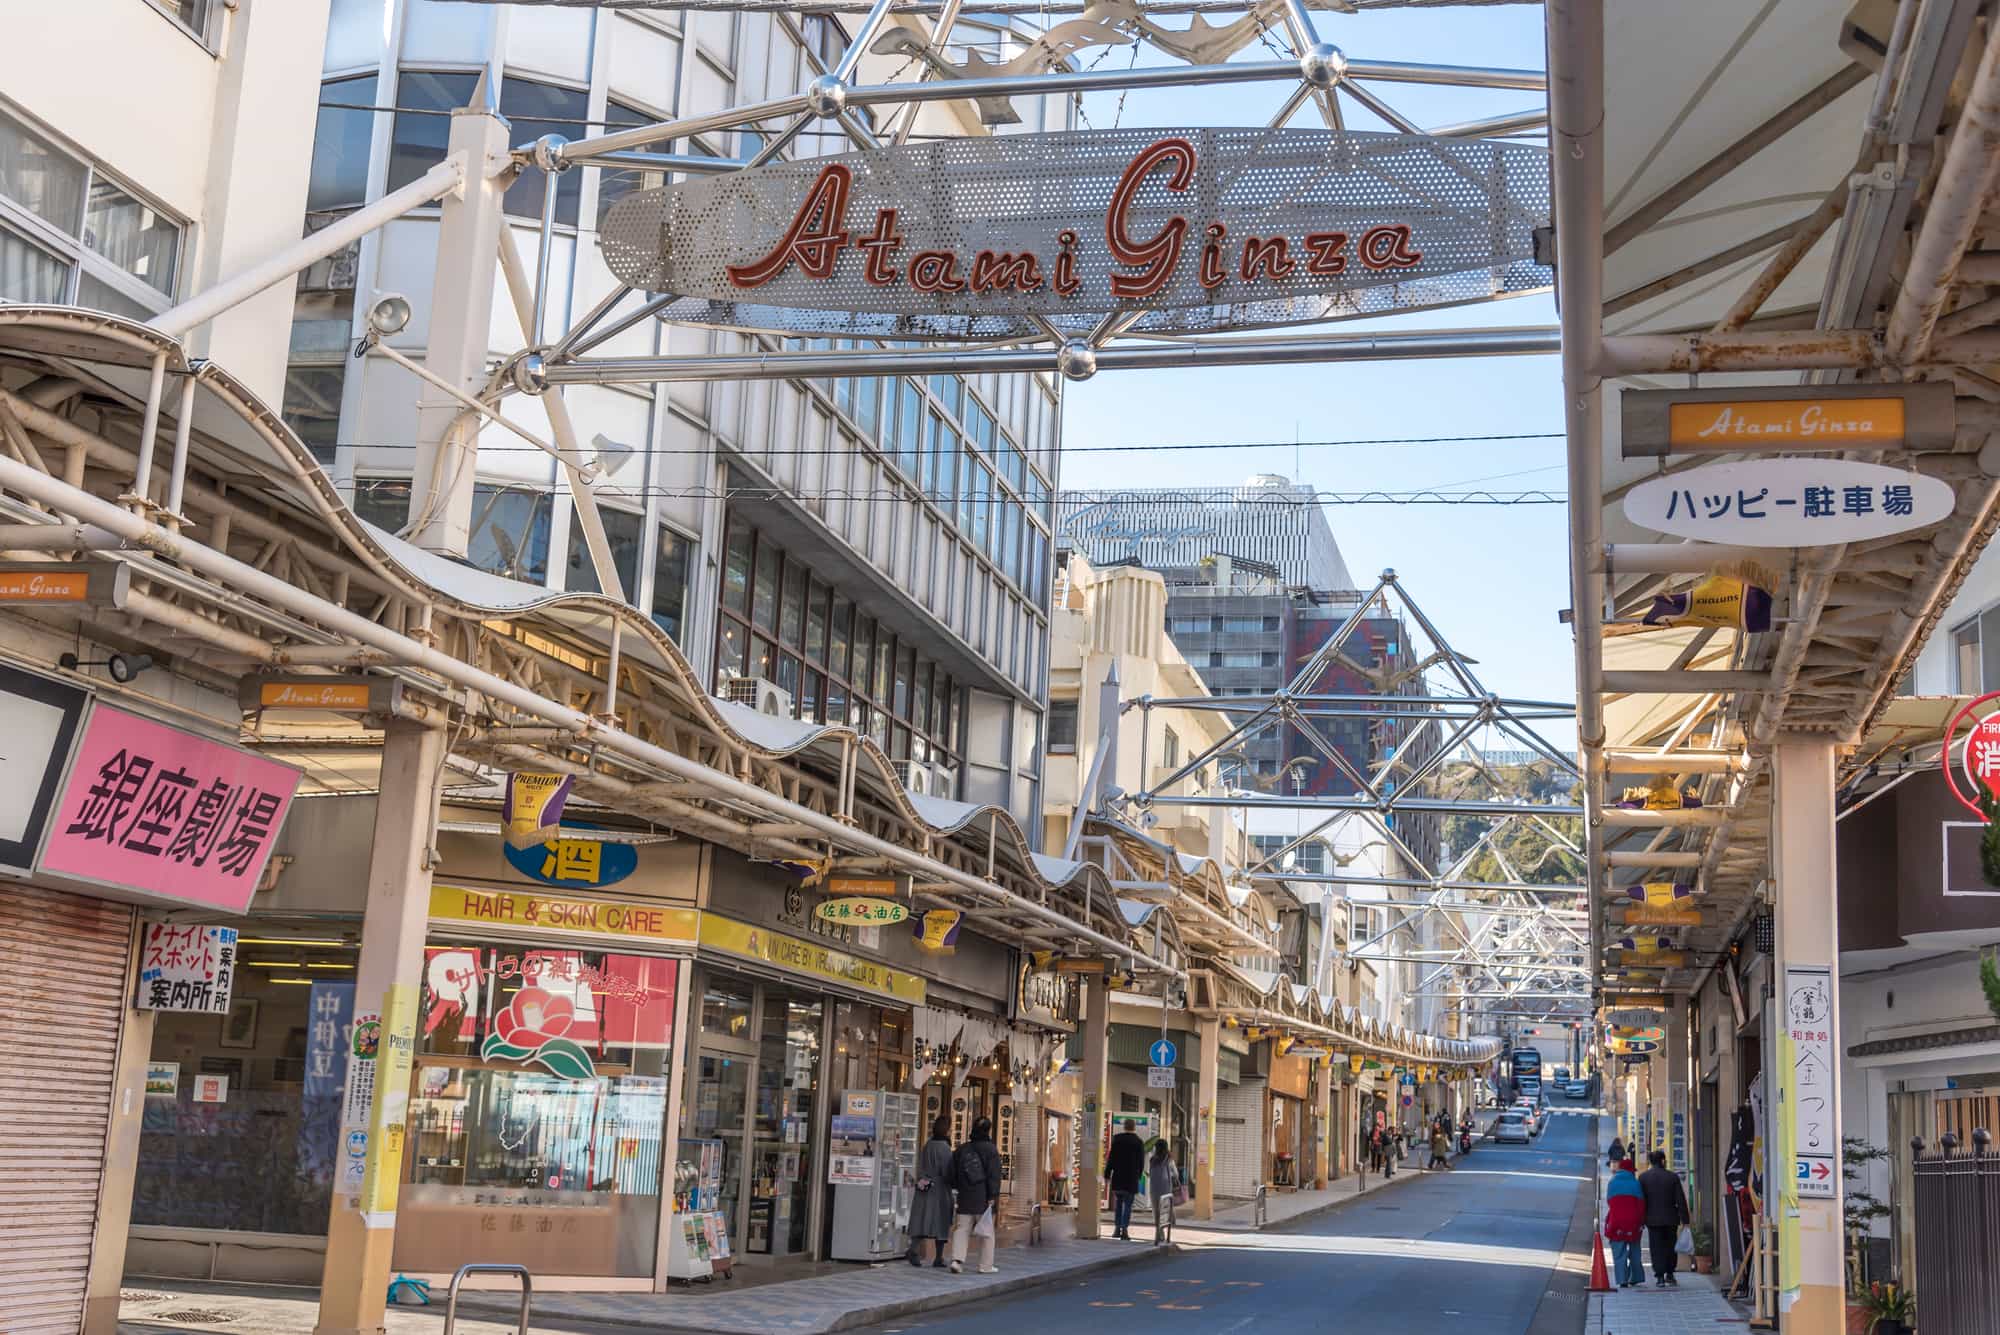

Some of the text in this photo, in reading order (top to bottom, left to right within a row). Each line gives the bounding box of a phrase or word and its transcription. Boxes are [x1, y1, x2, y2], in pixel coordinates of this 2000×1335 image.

[727, 137, 1424, 298] Atami Ginza
[1698, 405, 1873, 437] Atami Ginza
[1666, 485, 1914, 519] ハッピー駐車場
[29, 575, 71, 596] Ginza
[273, 687, 356, 704] Atami Ginza
[514, 773, 562, 787] PREMIUM
[66, 748, 283, 878] 銀座劇場
[540, 840, 602, 884] 酒
[463, 894, 663, 933] HAIR & SKIN CARE
[163, 925, 210, 950] ナイト
[147, 945, 214, 972] スポット
[149, 979, 214, 1011] 案内所
[213, 947, 234, 1012] 案内所
[1792, 1030, 1829, 1042] 和食処
